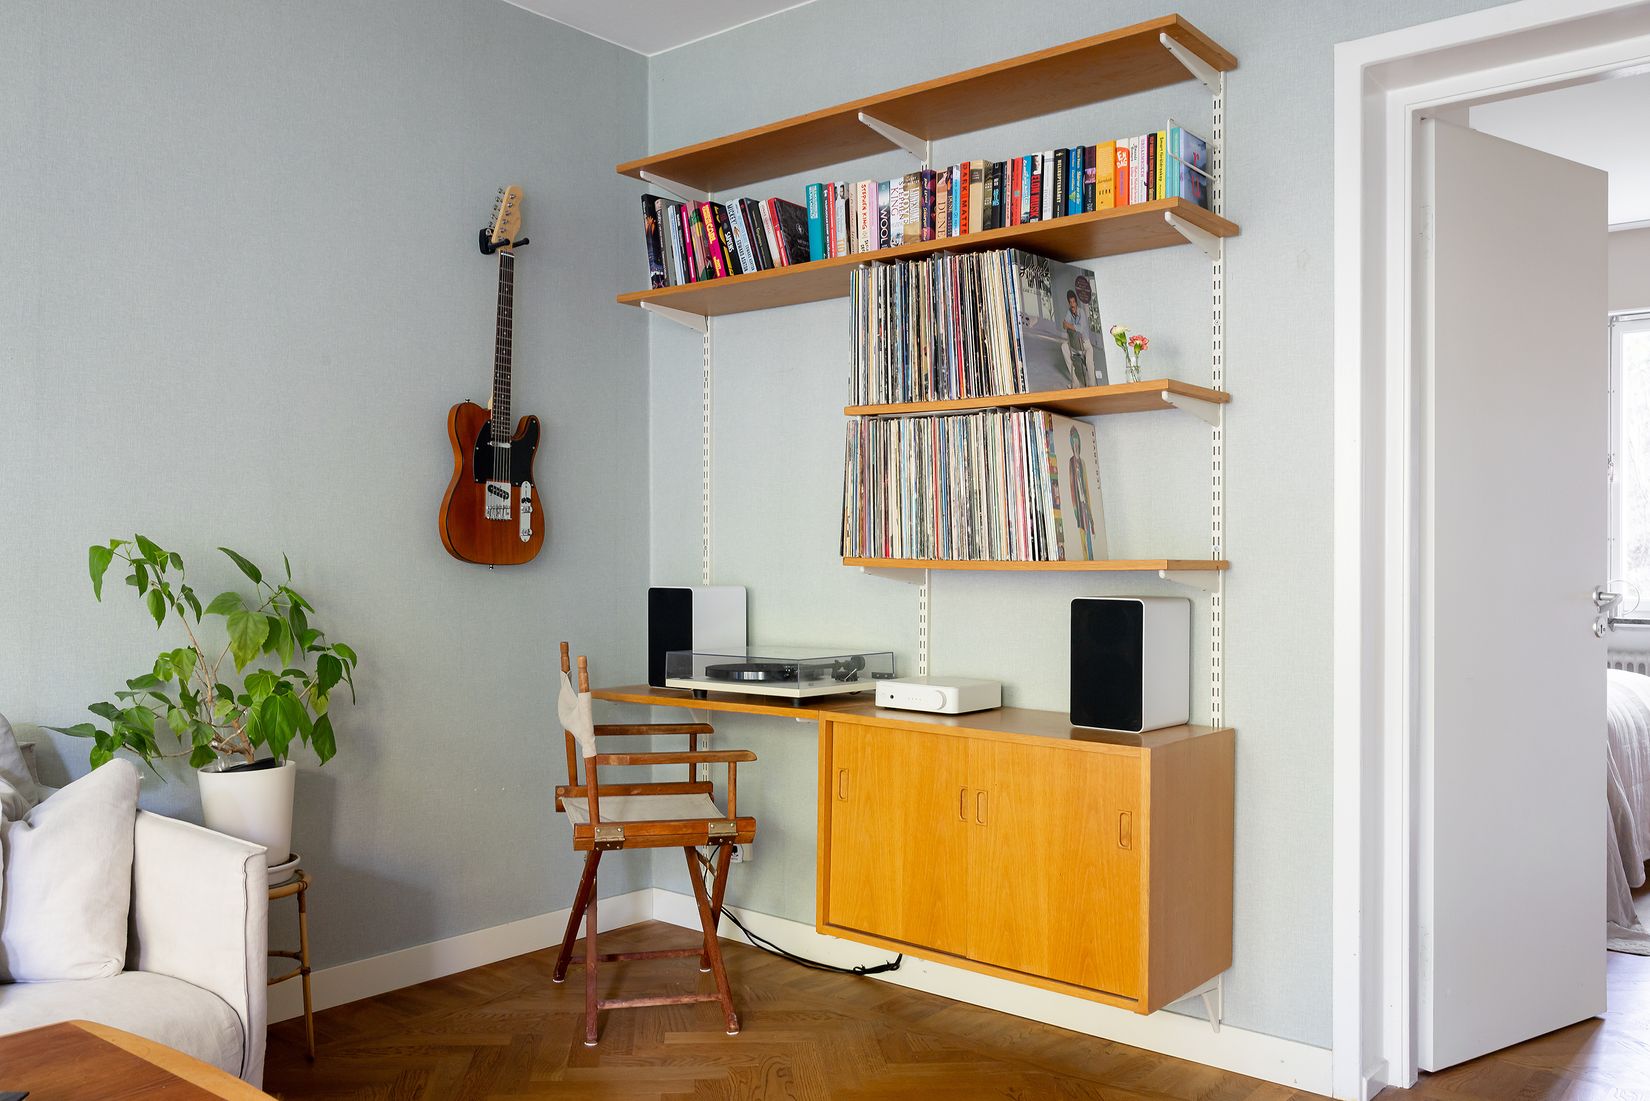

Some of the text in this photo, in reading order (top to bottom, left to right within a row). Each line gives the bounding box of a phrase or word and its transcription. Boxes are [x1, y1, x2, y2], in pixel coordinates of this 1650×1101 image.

[891, 187, 899, 216] KING
[910, 186, 920, 224] LONESOME
[1030, 174, 1040, 218] ELON MUSK
[938, 200, 946, 238] DUNE
[724, 231, 734, 253] SAPIENS
